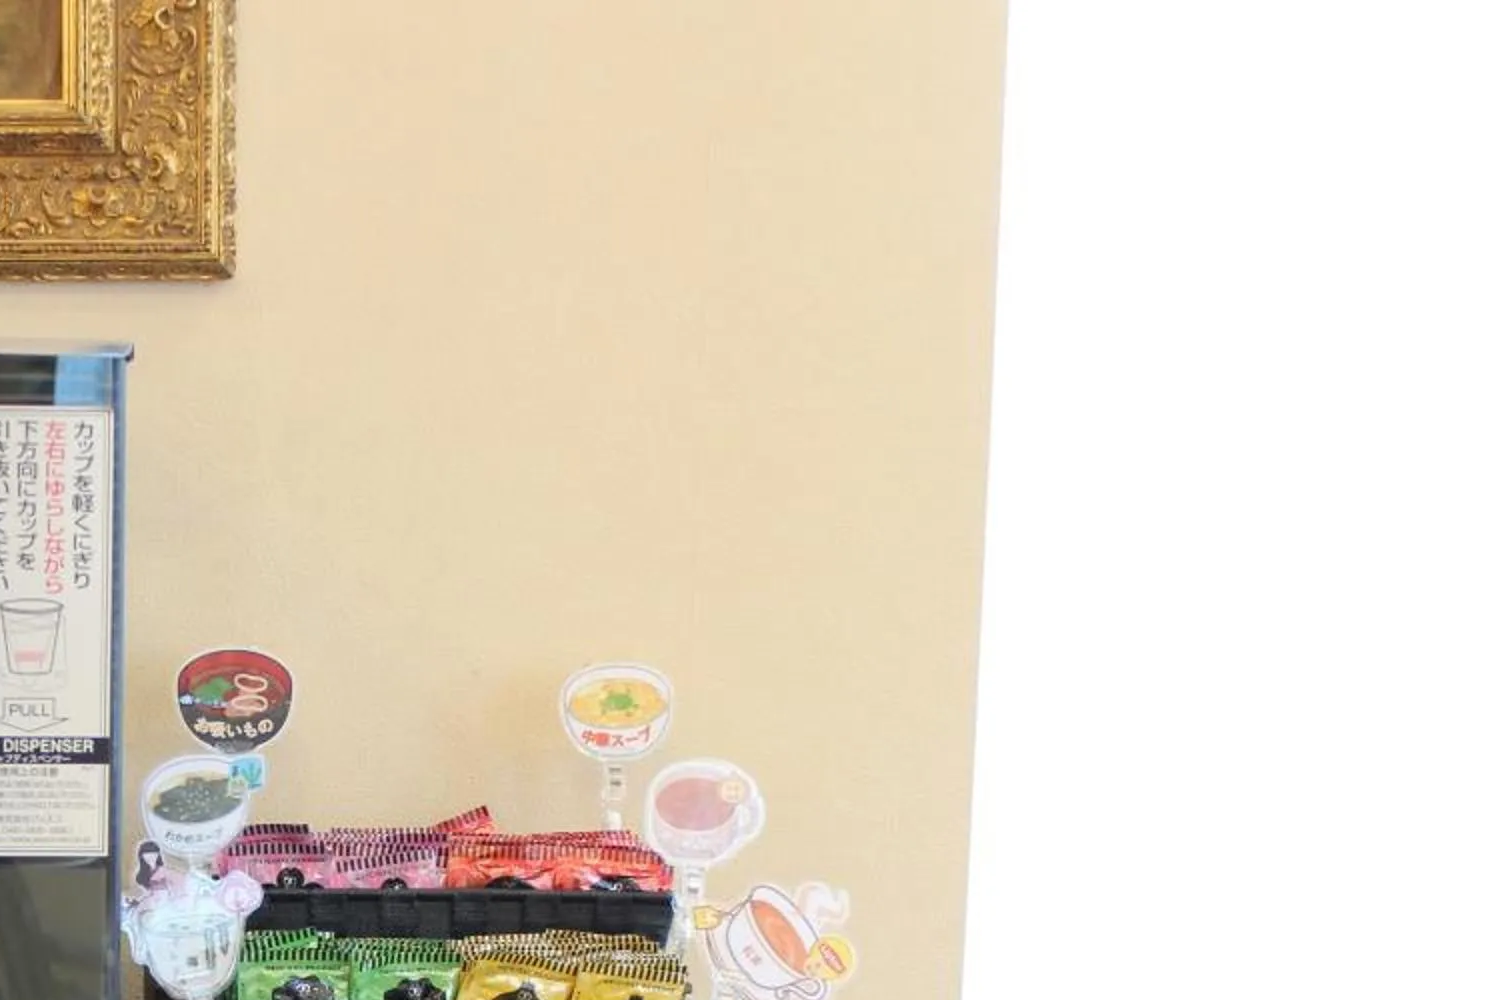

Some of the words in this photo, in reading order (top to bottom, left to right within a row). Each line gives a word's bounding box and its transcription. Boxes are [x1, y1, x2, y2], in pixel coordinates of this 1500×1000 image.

[16, 420, 38, 571] 下方向にカップを
[43, 420, 67, 595] 左右にゆらしながら
[72, 422, 95, 590] カップを軽くにぎり
[3, 739, 94, 753] DISPENSER
[9, 703, 50, 717] PULL
